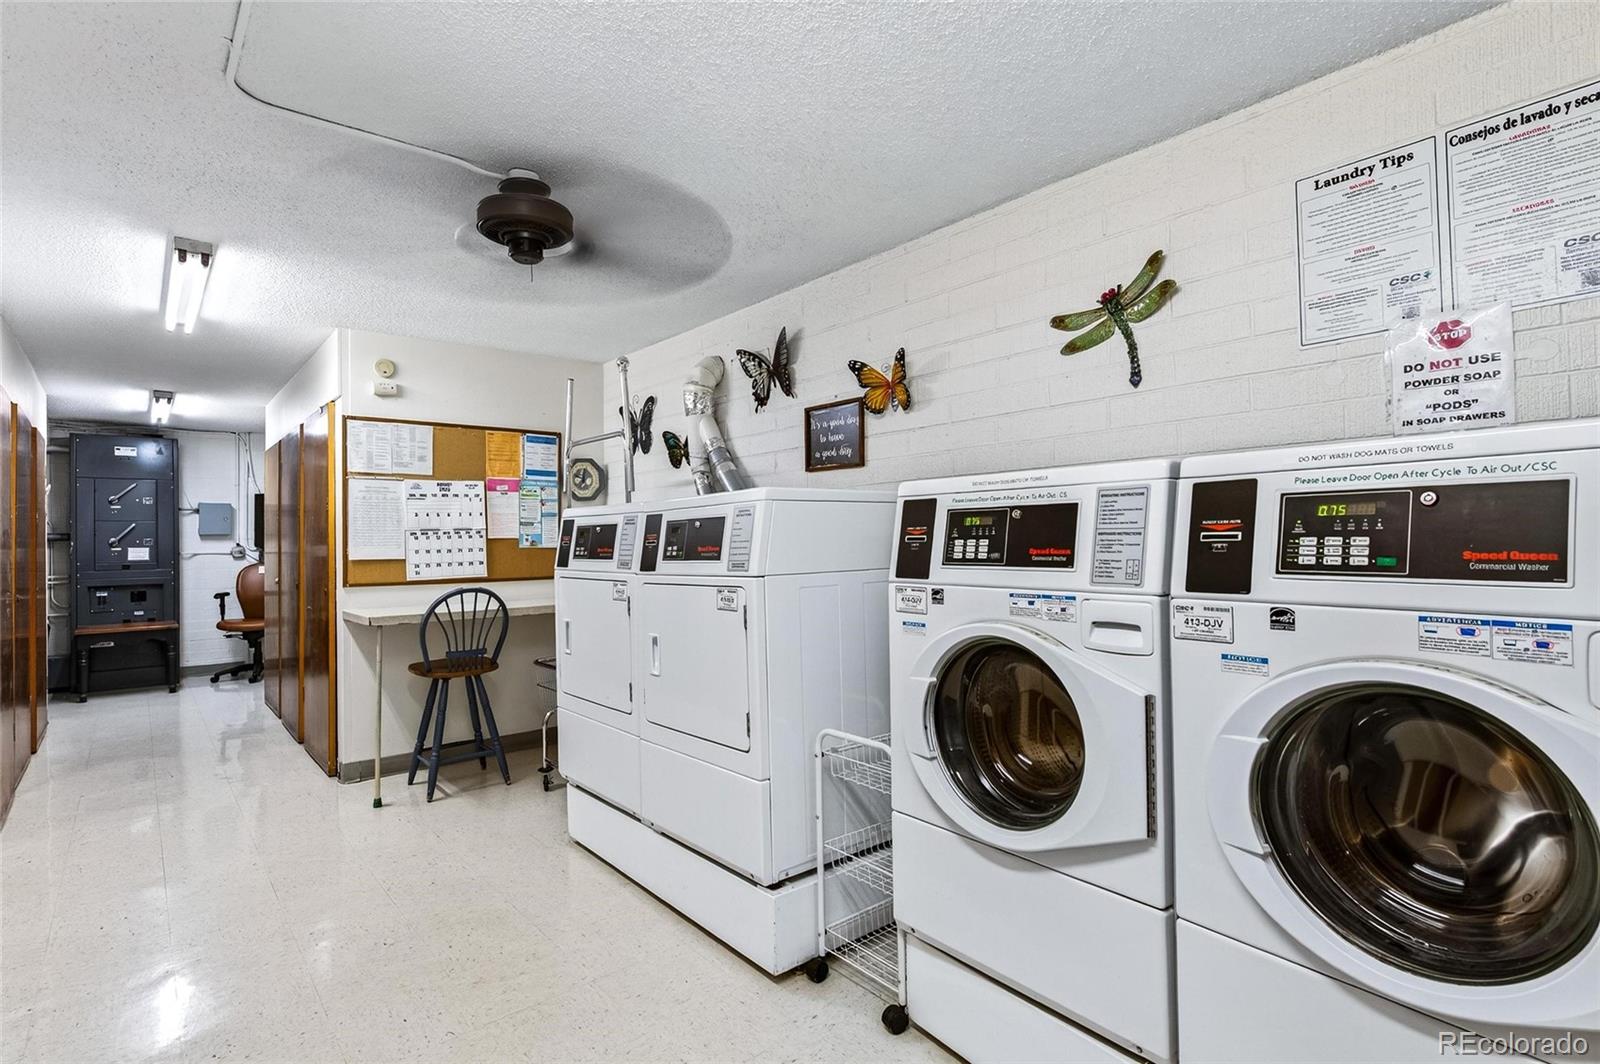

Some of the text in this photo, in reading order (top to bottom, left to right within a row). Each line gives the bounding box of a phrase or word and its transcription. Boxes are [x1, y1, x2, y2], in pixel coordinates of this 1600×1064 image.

[1449, 124, 1500, 147] Consejos
[1503, 117, 1518, 131] de
[1520, 103, 1562, 126] lavado
[1564, 101, 1572, 115] y
[1314, 152, 1414, 191] Laundry Tips
[1389, 273, 1422, 287] CSC
[1404, 352, 1502, 374] DO NOT USE
[1404, 370, 1502, 390] POWDER SOAP
[1444, 388, 1460, 396] OR
[830, 415, 845, 430] good
[1402, 410, 1506, 428] IN SOAP DRAWERS
[1329, 452, 1352, 460] WASH
[1354, 450, 1374, 458] DOG
[1374, 448, 1398, 456] MATS
[1400, 446, 1414, 454] OR
[1416, 442, 1454, 453] TOWELS
[1294, 476, 1319, 484] Please
[1321, 475, 1348, 483] Leave
[1349, 473, 1372, 482] Door
[1374, 472, 1399, 482] Open
[1400, 469, 1429, 479] After
[1431, 468, 1462, 478] Cycle
[1466, 466, 1478, 475] To
[1480, 464, 1498, 474] Air
[1462, 550, 1558, 561] Speed Queen
[1469, 562, 1550, 571] Commercial Washer
[1184, 618, 1224, 628] 413-DJV
